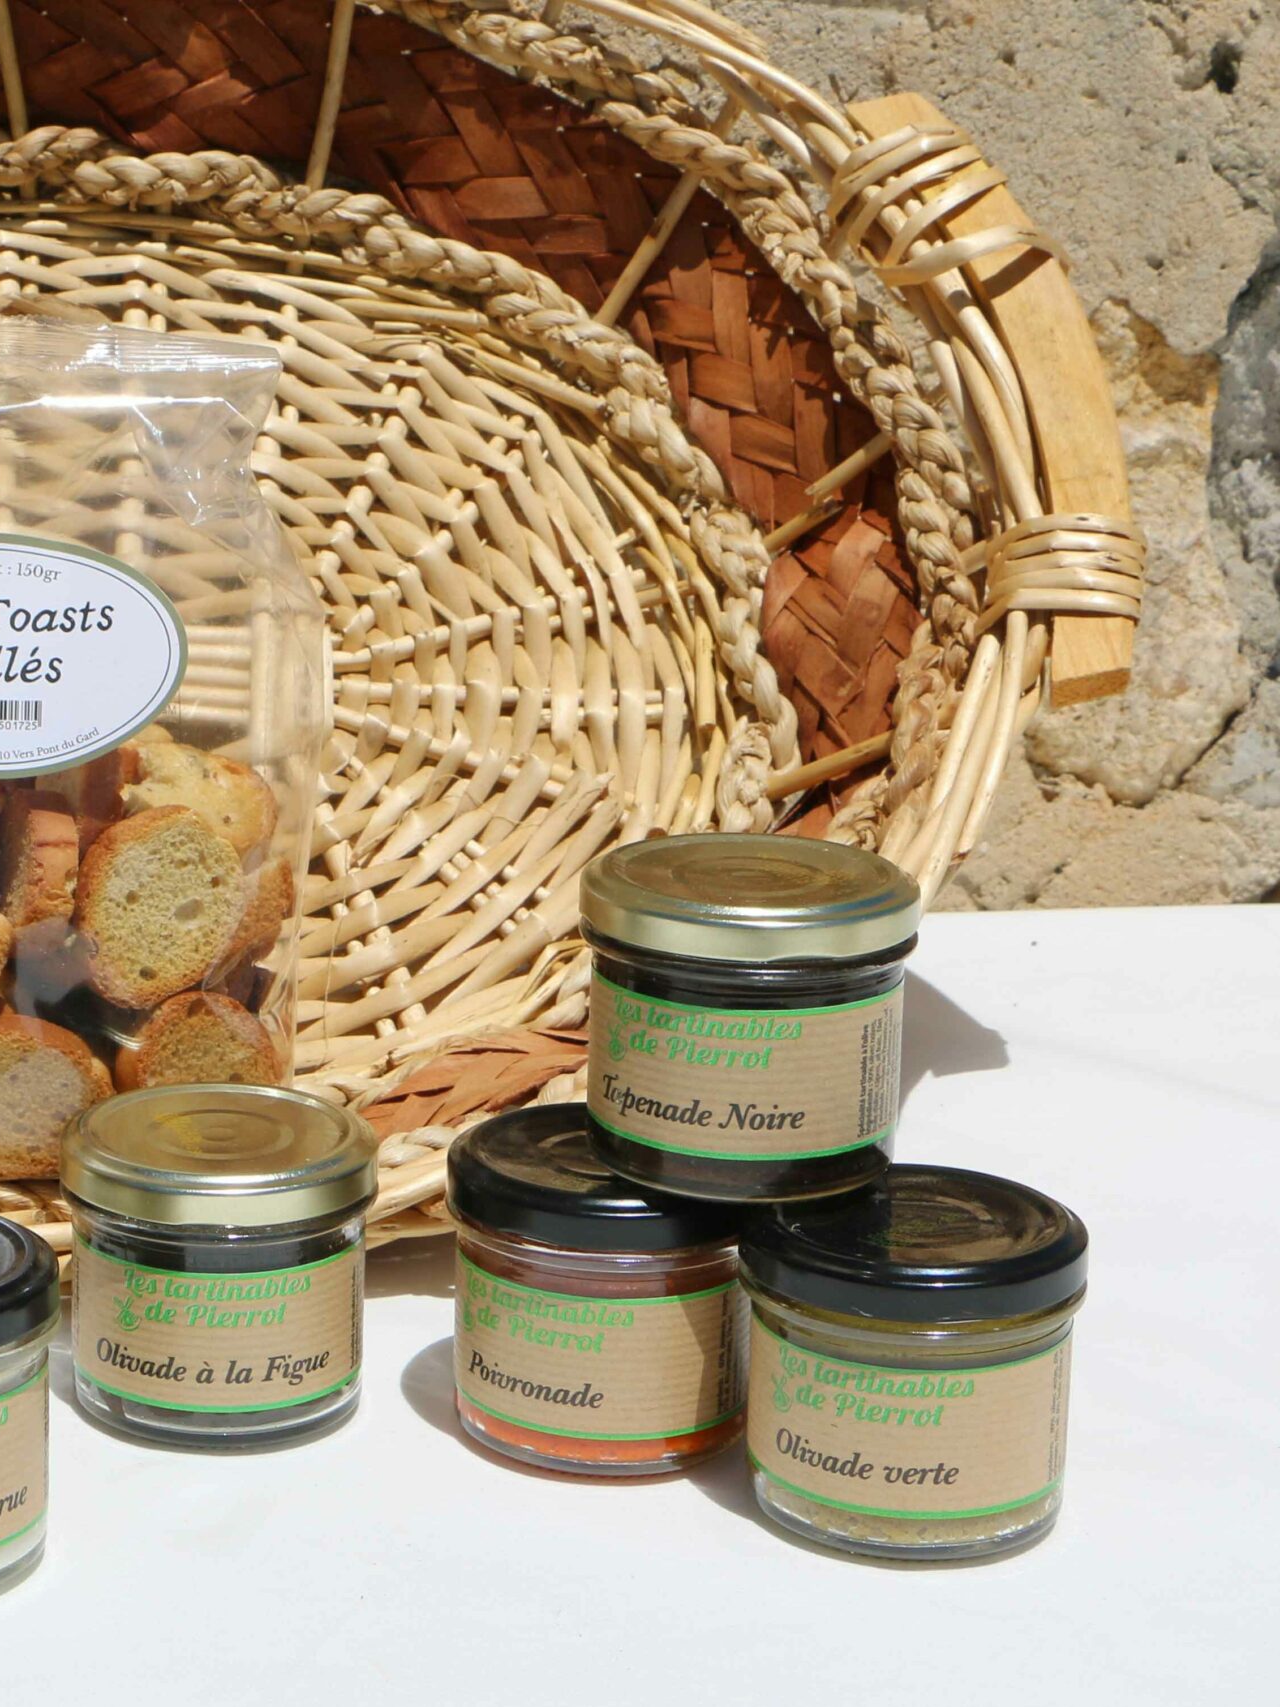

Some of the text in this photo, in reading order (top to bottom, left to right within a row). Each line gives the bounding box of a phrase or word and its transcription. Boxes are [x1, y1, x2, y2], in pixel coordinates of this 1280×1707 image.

[16, 563, 63, 583] 150gr
[12, 750, 34, 760] Vers
[37, 745, 59, 757] Pont
[61, 740, 74, 750] du
[76, 727, 100, 744] Gard
[646, 1004, 802, 1041] tartinables
[628, 1029, 774, 1070] de Pierrot
[718, 1103, 806, 1131] Noire
[122, 1266, 311, 1301] Les tartinables
[144, 1301, 287, 1328] de Pierrot
[490, 1282, 635, 1329] tartinables
[477, 1305, 606, 1355] de Pierrot
[96, 1337, 331, 1386] Olivade à la Figue
[468, 1349, 604, 1409] Poivronade
[812, 1362, 975, 1399] tartinables
[795, 1384, 946, 1428] de Pierrot
[776, 1427, 960, 1486] Olivade verte
